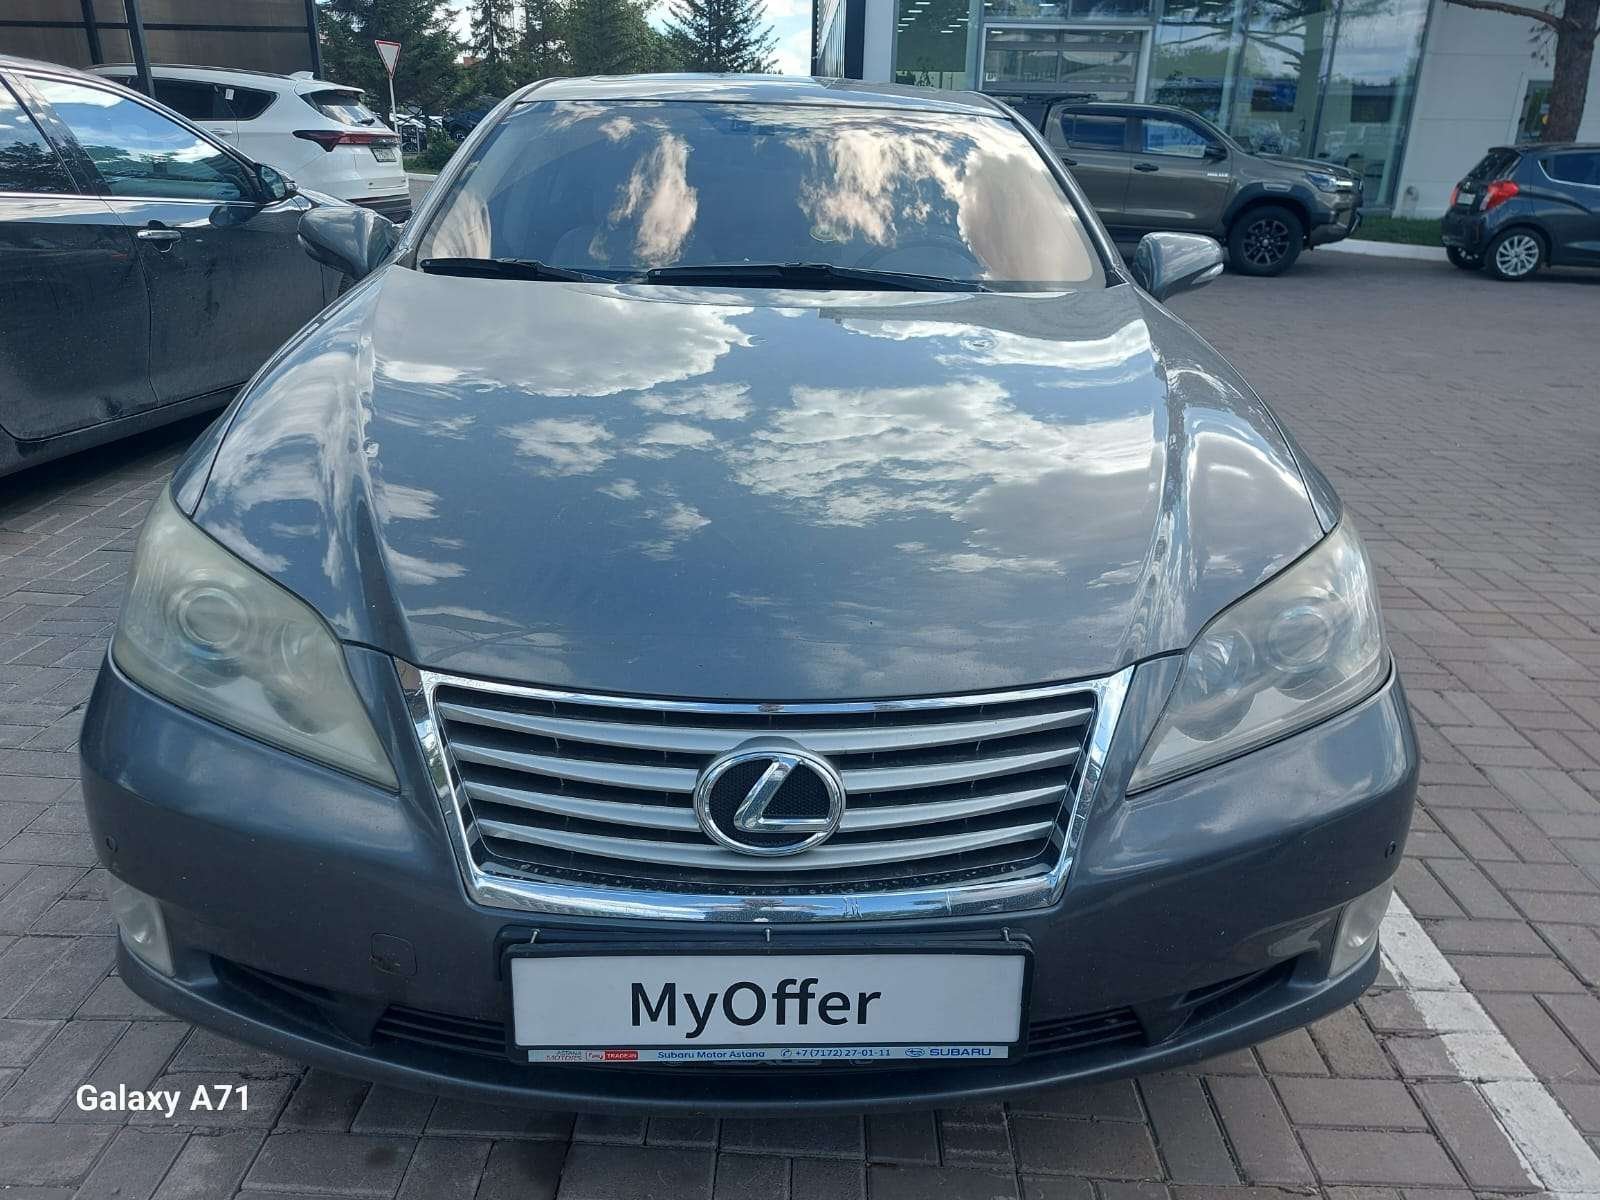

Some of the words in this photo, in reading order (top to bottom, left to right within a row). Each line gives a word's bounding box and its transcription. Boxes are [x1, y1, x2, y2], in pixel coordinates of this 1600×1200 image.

[631, 977, 882, 1039] MyOffer
[657, 1051, 694, 1059] Subaru
[697, 1050, 727, 1059] Motor
[729, 1050, 766, 1058] Astana
[844, 1048, 891, 1057] 27-01-11
[929, 1048, 992, 1056] SUBARU
